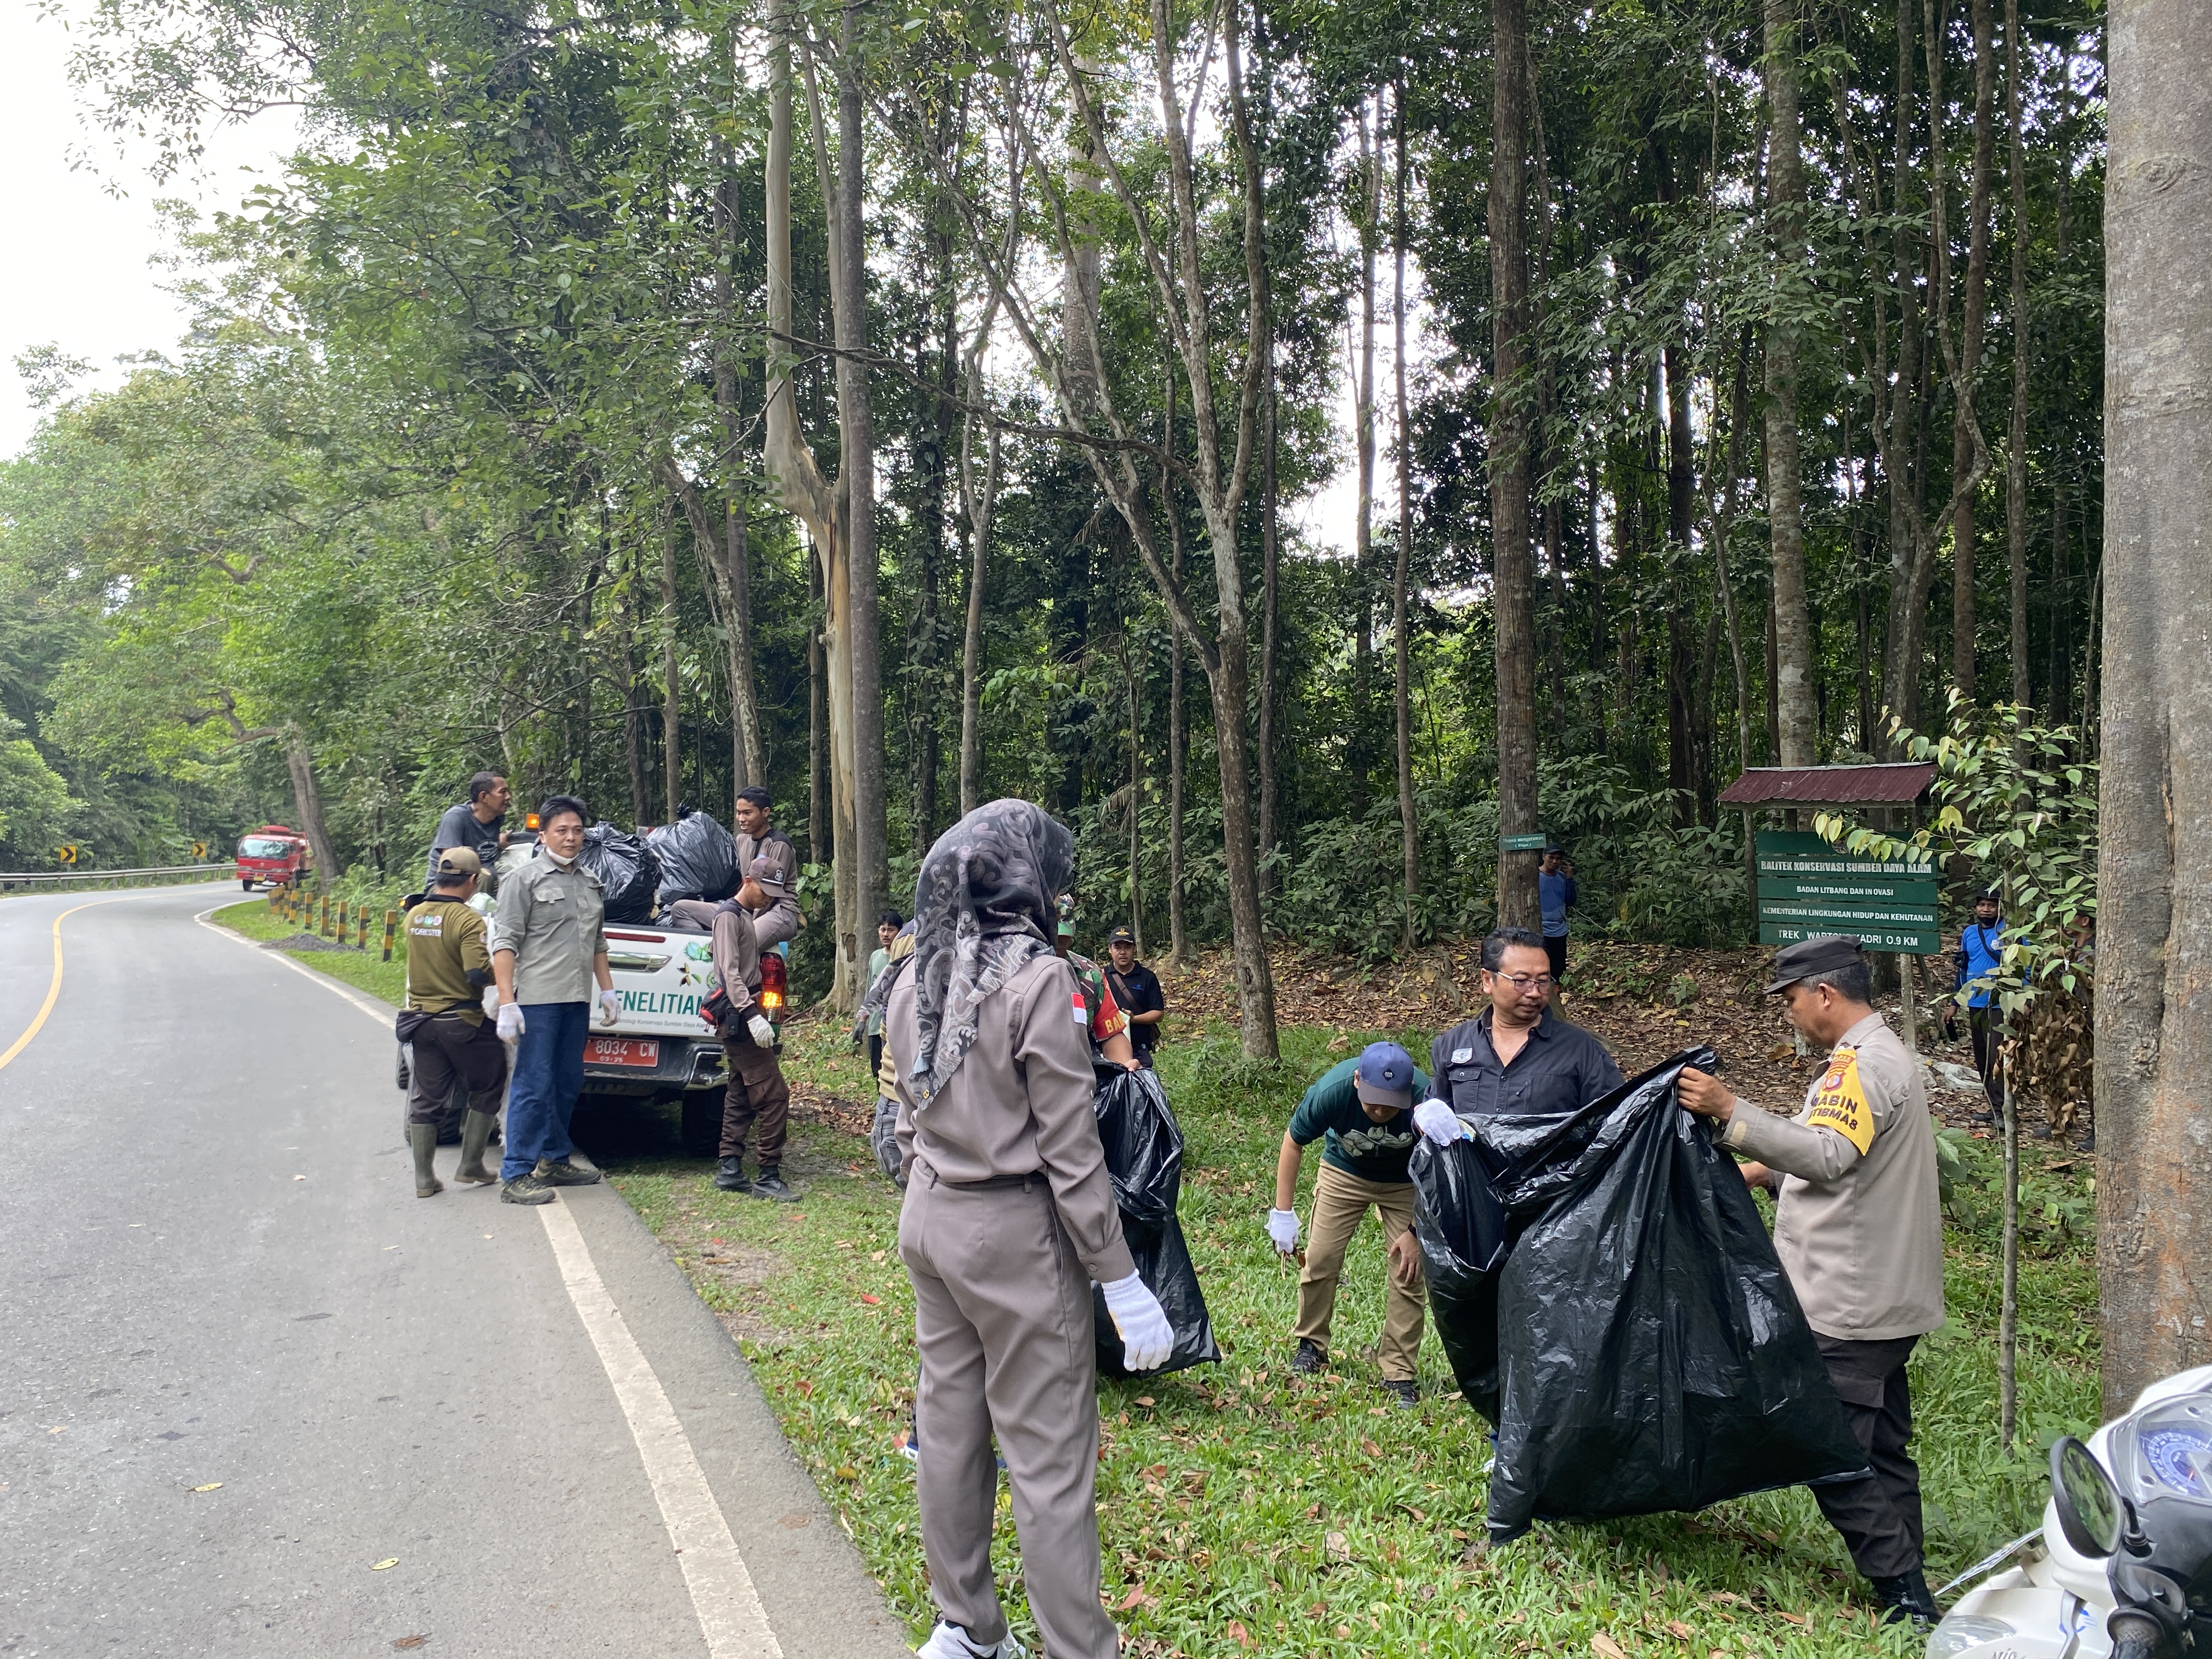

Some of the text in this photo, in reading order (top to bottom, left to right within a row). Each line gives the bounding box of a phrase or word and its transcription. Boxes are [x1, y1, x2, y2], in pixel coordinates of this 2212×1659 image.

[1760, 860, 1932, 874] BALITEK KONSERVASI SUMBER DAYA ALAM
[1796, 885, 1819, 894] BADAN
[1763, 907, 1807, 916] KEMENTERIAN
[1808, 909, 1851, 918] LINGKUNGAN
[1852, 911, 1874, 919] HIDUP
[1891, 913, 1933, 922] KEHUTANAN
[1778, 929, 1800, 940] TREK
[1903, 936, 1918, 946] KM
[596, 1039, 657, 1057] 8034 CW
